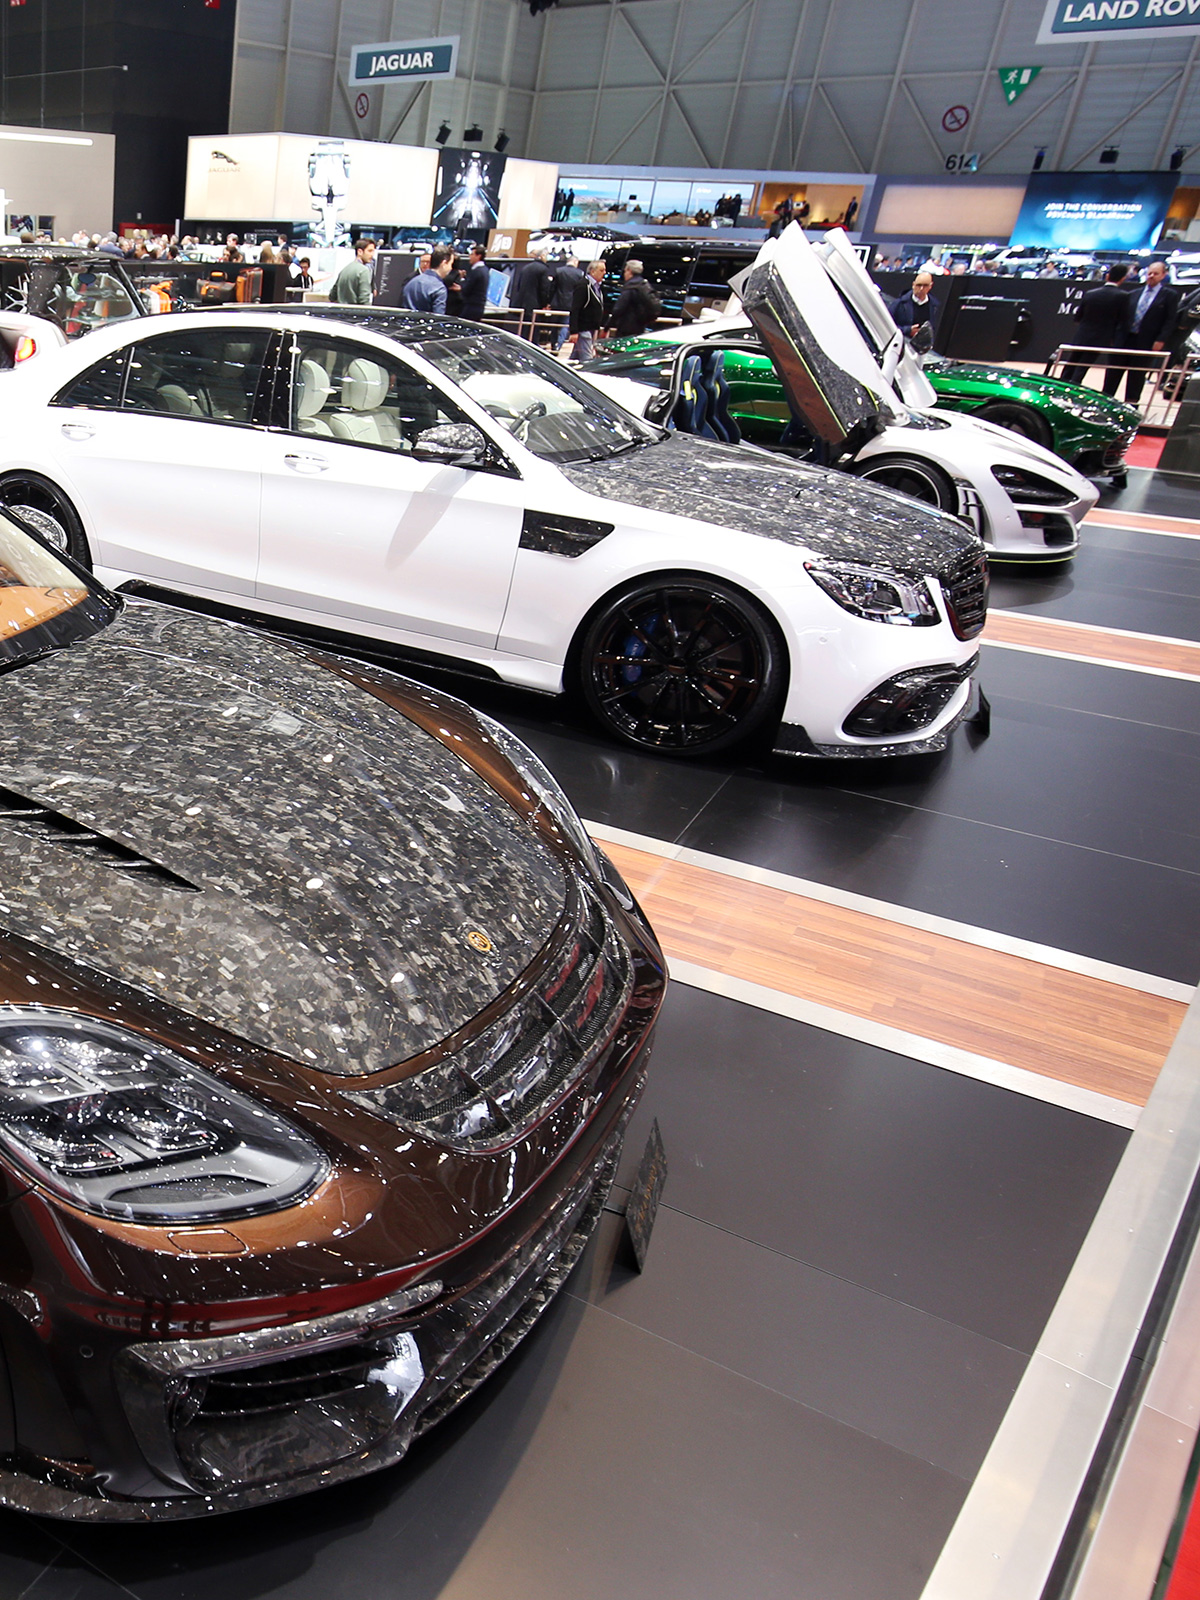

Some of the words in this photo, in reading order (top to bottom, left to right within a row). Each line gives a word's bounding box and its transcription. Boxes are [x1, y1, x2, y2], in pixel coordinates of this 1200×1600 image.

[1062, 0, 1139, 24] LAND
[369, 51, 434, 76] JAGUAR
[945, 154, 977, 171] 614
